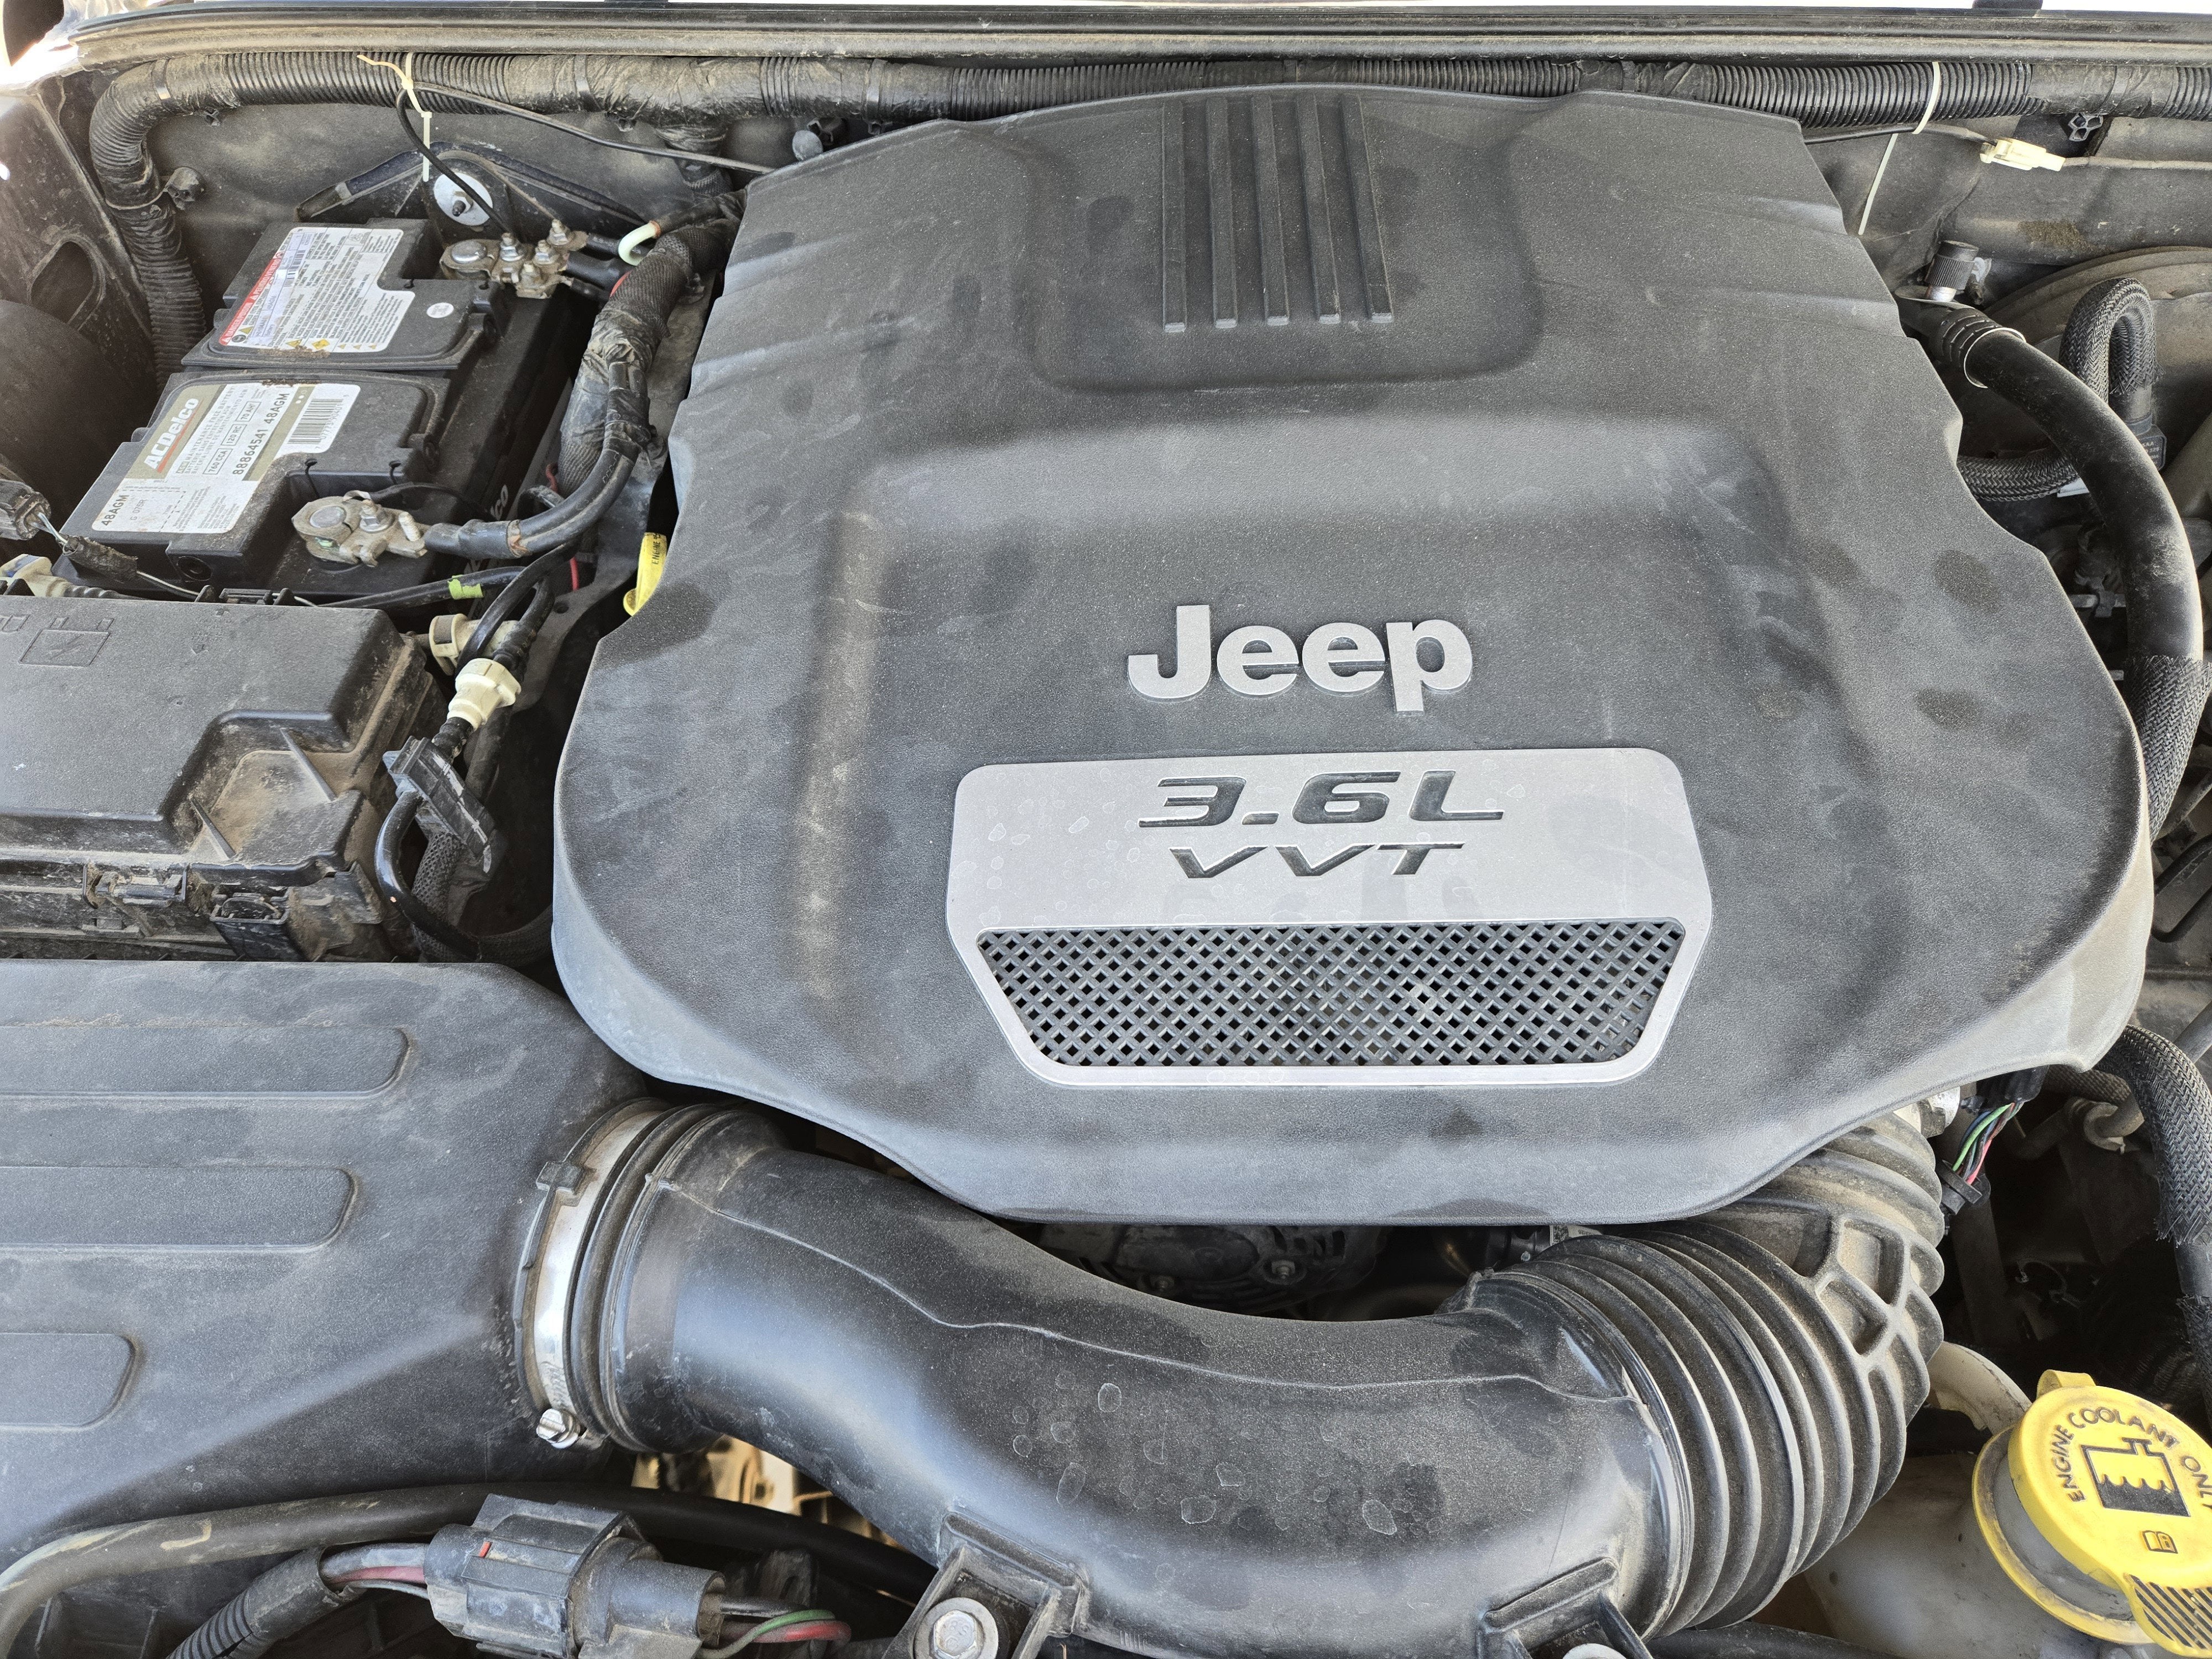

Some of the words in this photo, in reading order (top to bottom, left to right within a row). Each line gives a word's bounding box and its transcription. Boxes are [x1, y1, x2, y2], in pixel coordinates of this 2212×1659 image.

[143, 398, 200, 468] ACDelco
[226, 434, 237, 443] 120
[232, 429, 268, 474] 88864541
[264, 393, 289, 424] 48AGM
[208, 462, 220, 472] 760
[215, 451, 228, 461] CCA
[102, 495, 129, 525] 48AGM
[131, 499, 148, 513] 075R
[651, 541, 661, 565] ENGINE
[1128, 604, 1473, 714] Jeep
[1138, 770, 1505, 828] 3.6L
[1168, 842, 1465, 879] VVT
[2068, 1406, 2180, 1449] COOLANT
[2051, 1425, 2086, 1503] ENGINE
